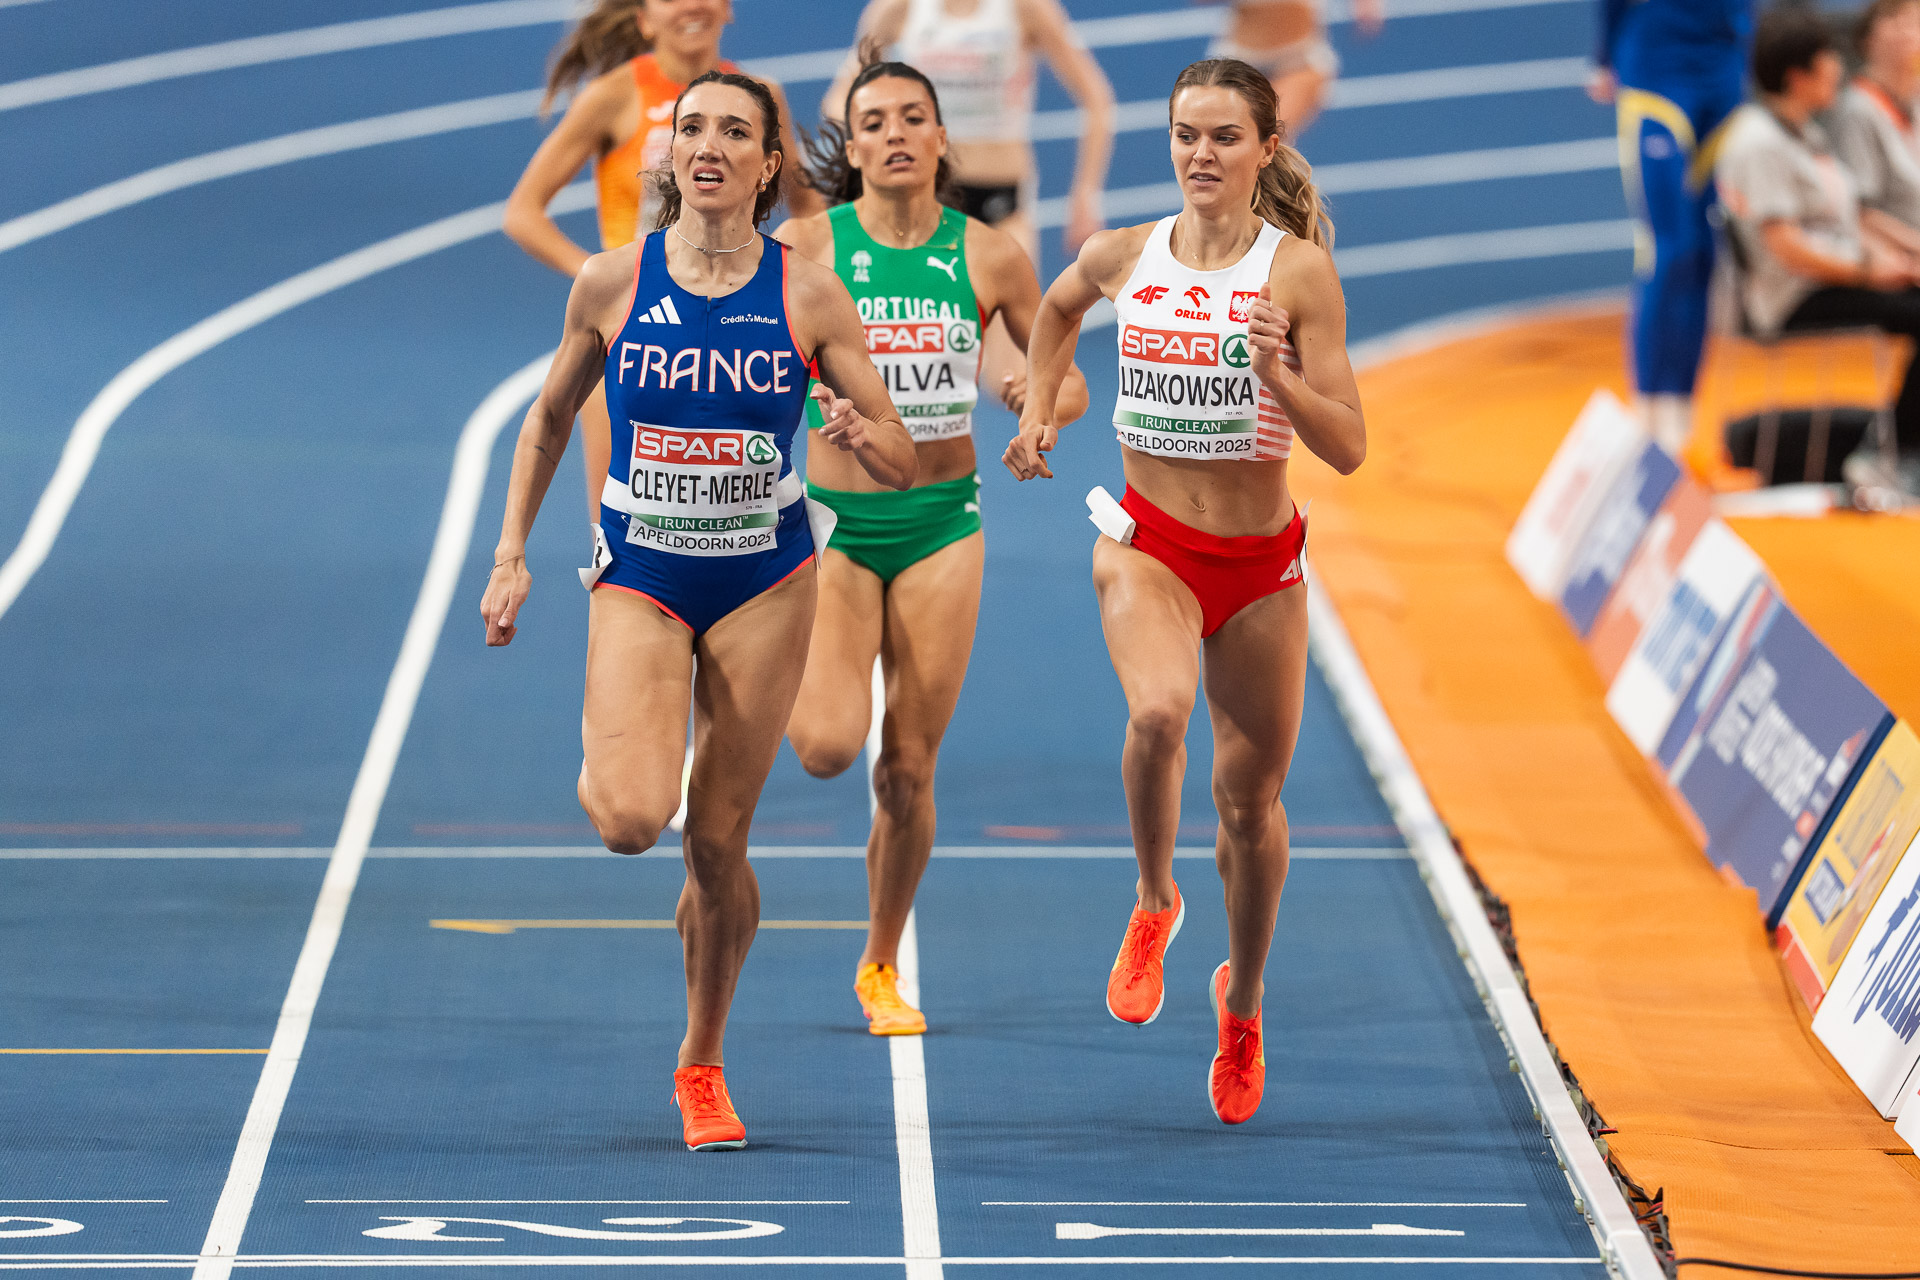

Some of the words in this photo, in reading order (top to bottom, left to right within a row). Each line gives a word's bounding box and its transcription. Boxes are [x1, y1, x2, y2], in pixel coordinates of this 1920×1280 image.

[1132, 285, 1169, 304] 4F
[720, 314, 745, 325] Crédit
[753, 315, 779, 325] Mutuel
[857, 296, 962, 321] ORTUGAL
[1175, 308, 1211, 321] ORLEN
[1124, 329, 1216, 362] SPAR
[618, 341, 792, 394] FRANCE
[874, 363, 955, 391] ILVA
[1121, 366, 1255, 407] LIZAKOWSKA
[1140, 415, 1144, 426] I
[1146, 416, 1172, 431] RUN
[638, 432, 741, 461] SPAR
[1215, 438, 1252, 453] 2025
[631, 468, 775, 505] CLEYET-MERLE
[658, 517, 662, 528] I
[665, 519, 695, 530] RUN
[634, 526, 734, 550] APELDOORN
[738, 532, 771, 549] 2025
